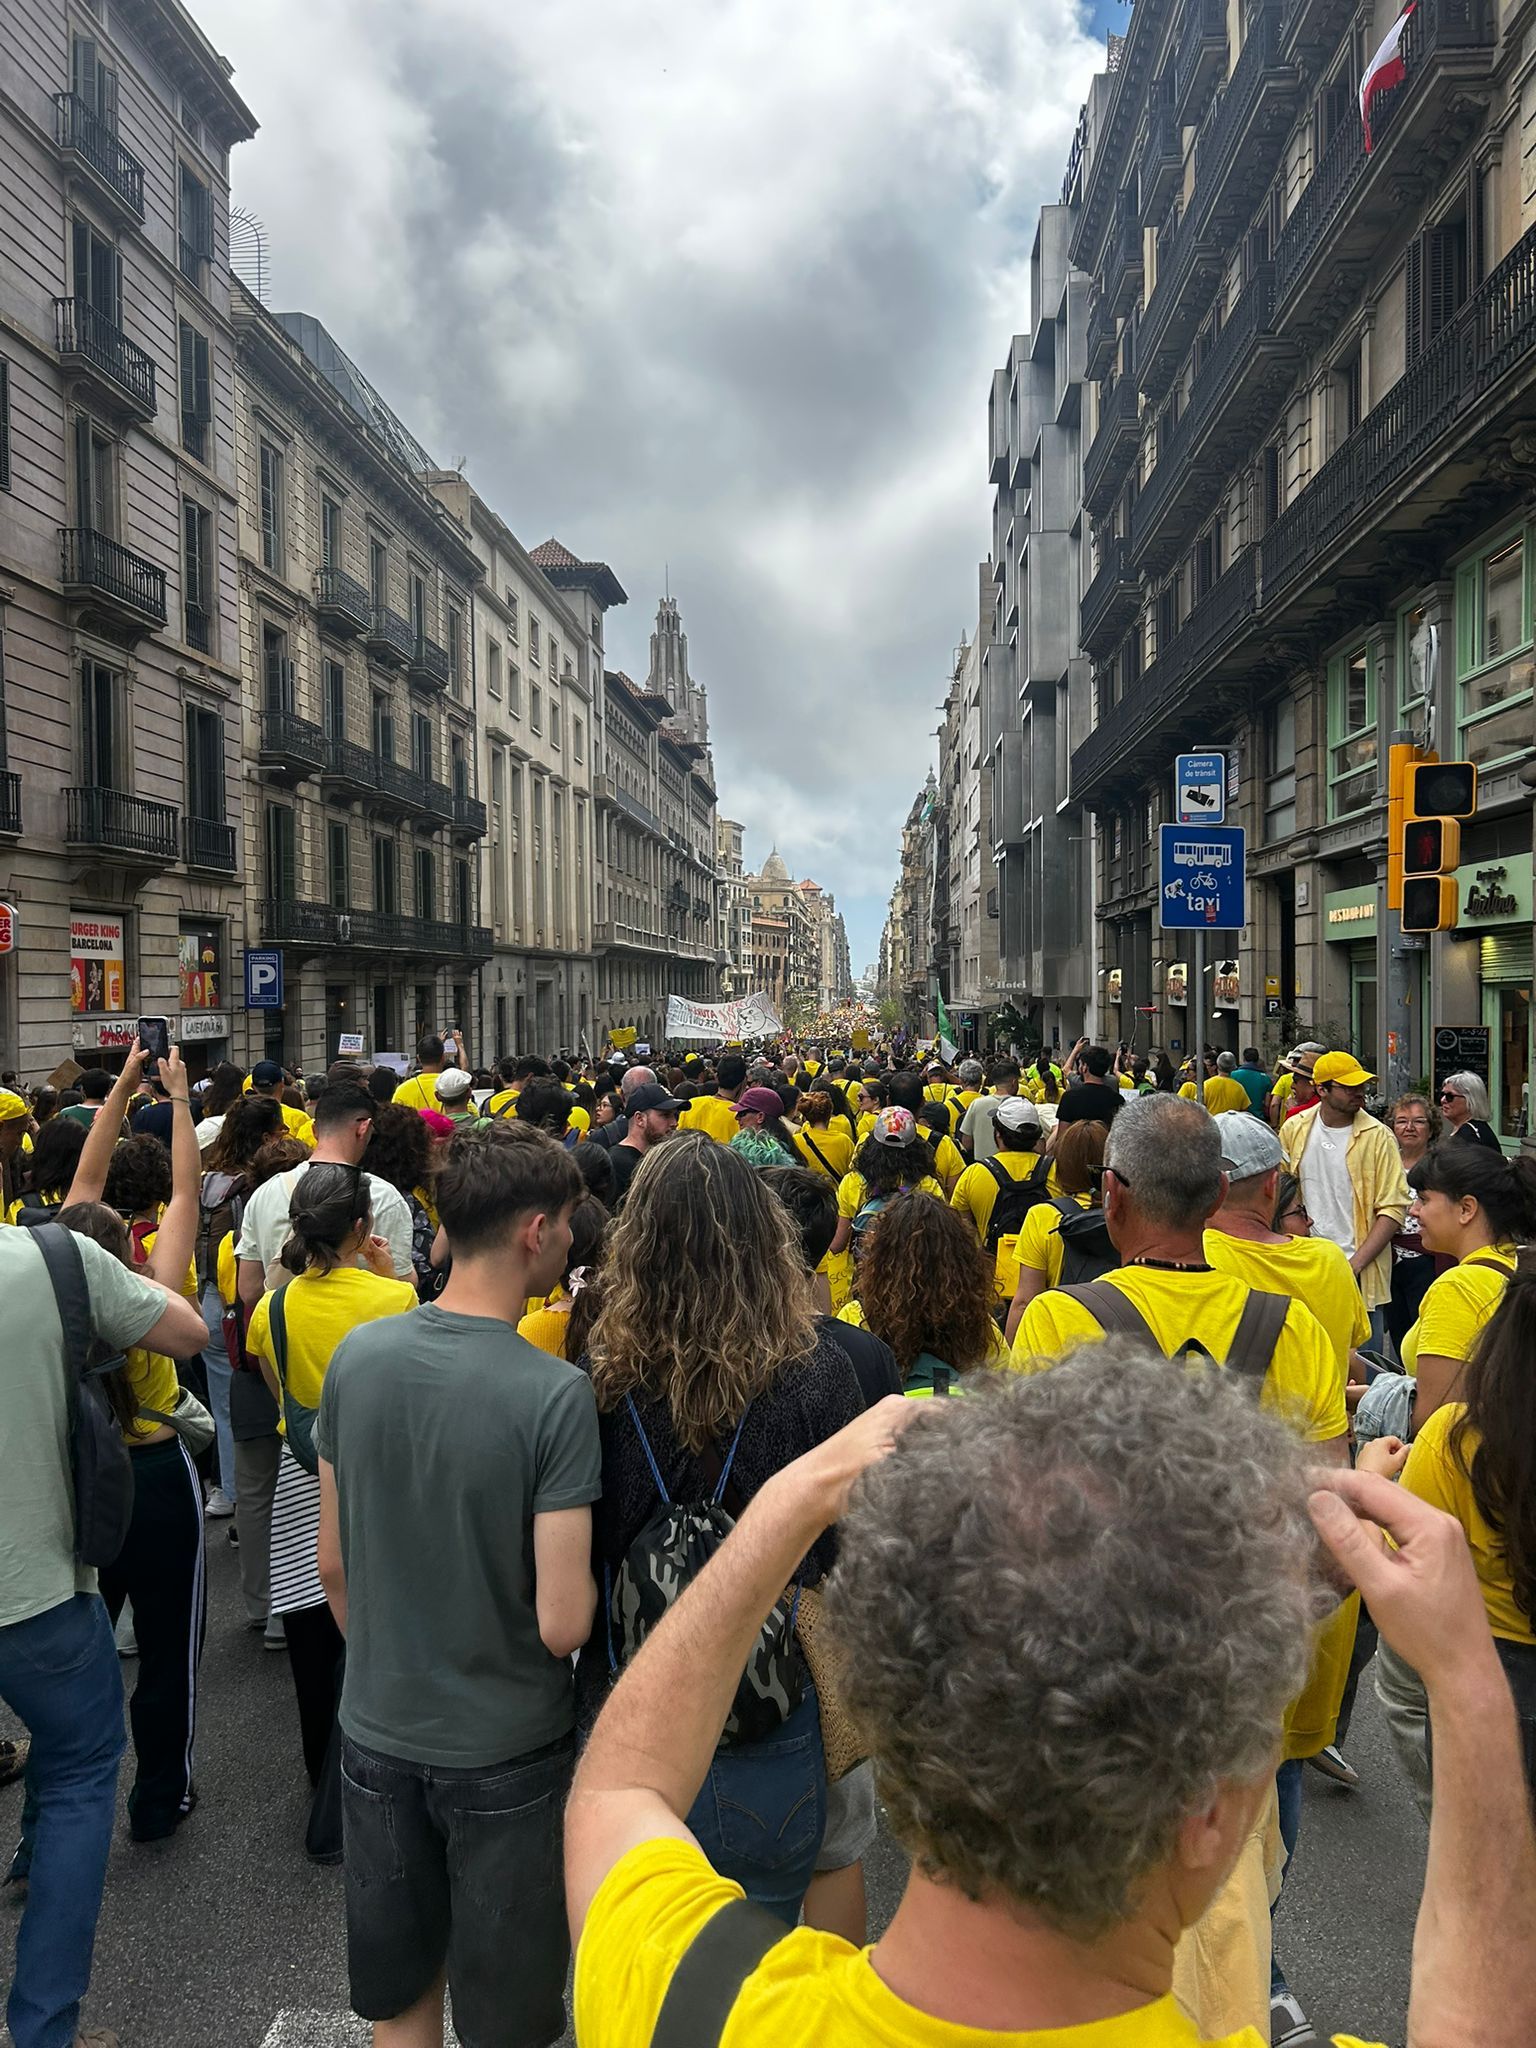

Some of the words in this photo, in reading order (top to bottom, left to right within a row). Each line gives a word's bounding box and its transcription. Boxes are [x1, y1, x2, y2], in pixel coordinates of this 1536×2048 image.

[1186, 892, 1220, 912] taxi
[100, 925, 120, 938] KING
[71, 938, 113, 951] BARCELONA
[252, 964, 276, 994] P
[997, 979, 1026, 989] Hotel
[1269, 1001, 1278, 1012] P
